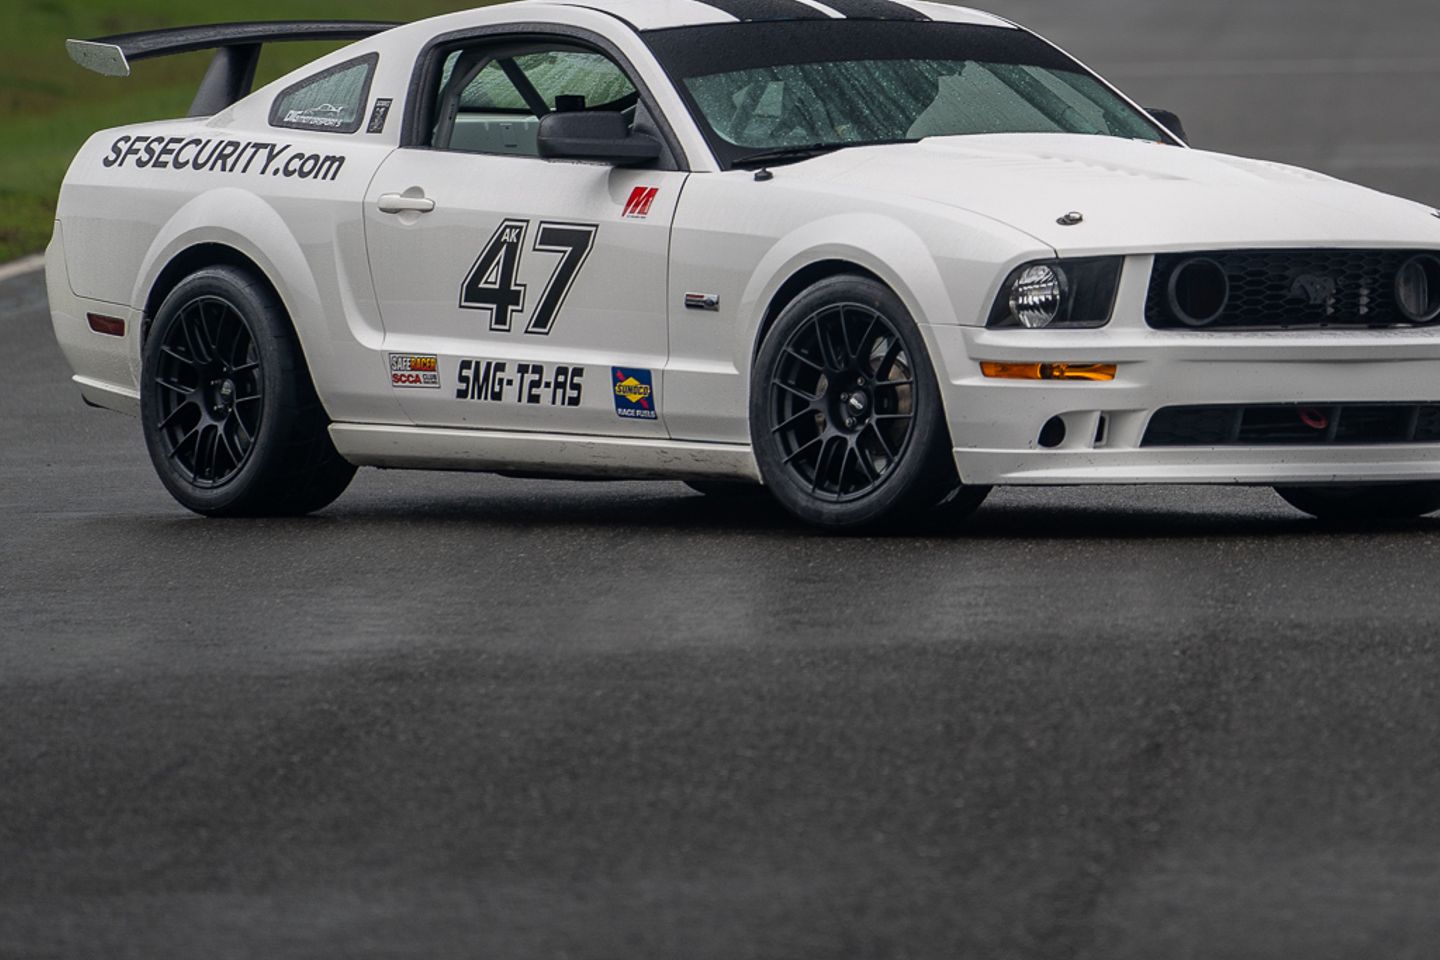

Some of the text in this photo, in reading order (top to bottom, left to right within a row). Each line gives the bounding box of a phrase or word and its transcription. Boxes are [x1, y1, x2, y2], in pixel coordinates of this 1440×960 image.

[103, 136, 346, 181] SFSECURITY.com
[501, 228, 520, 243] AK
[458, 217, 600, 337] 47
[392, 372, 422, 385] SCCA
[456, 359, 584, 407] SMG-T2-AS
[615, 382, 650, 397] SUNOCO
[617, 408, 635, 417] RACE
